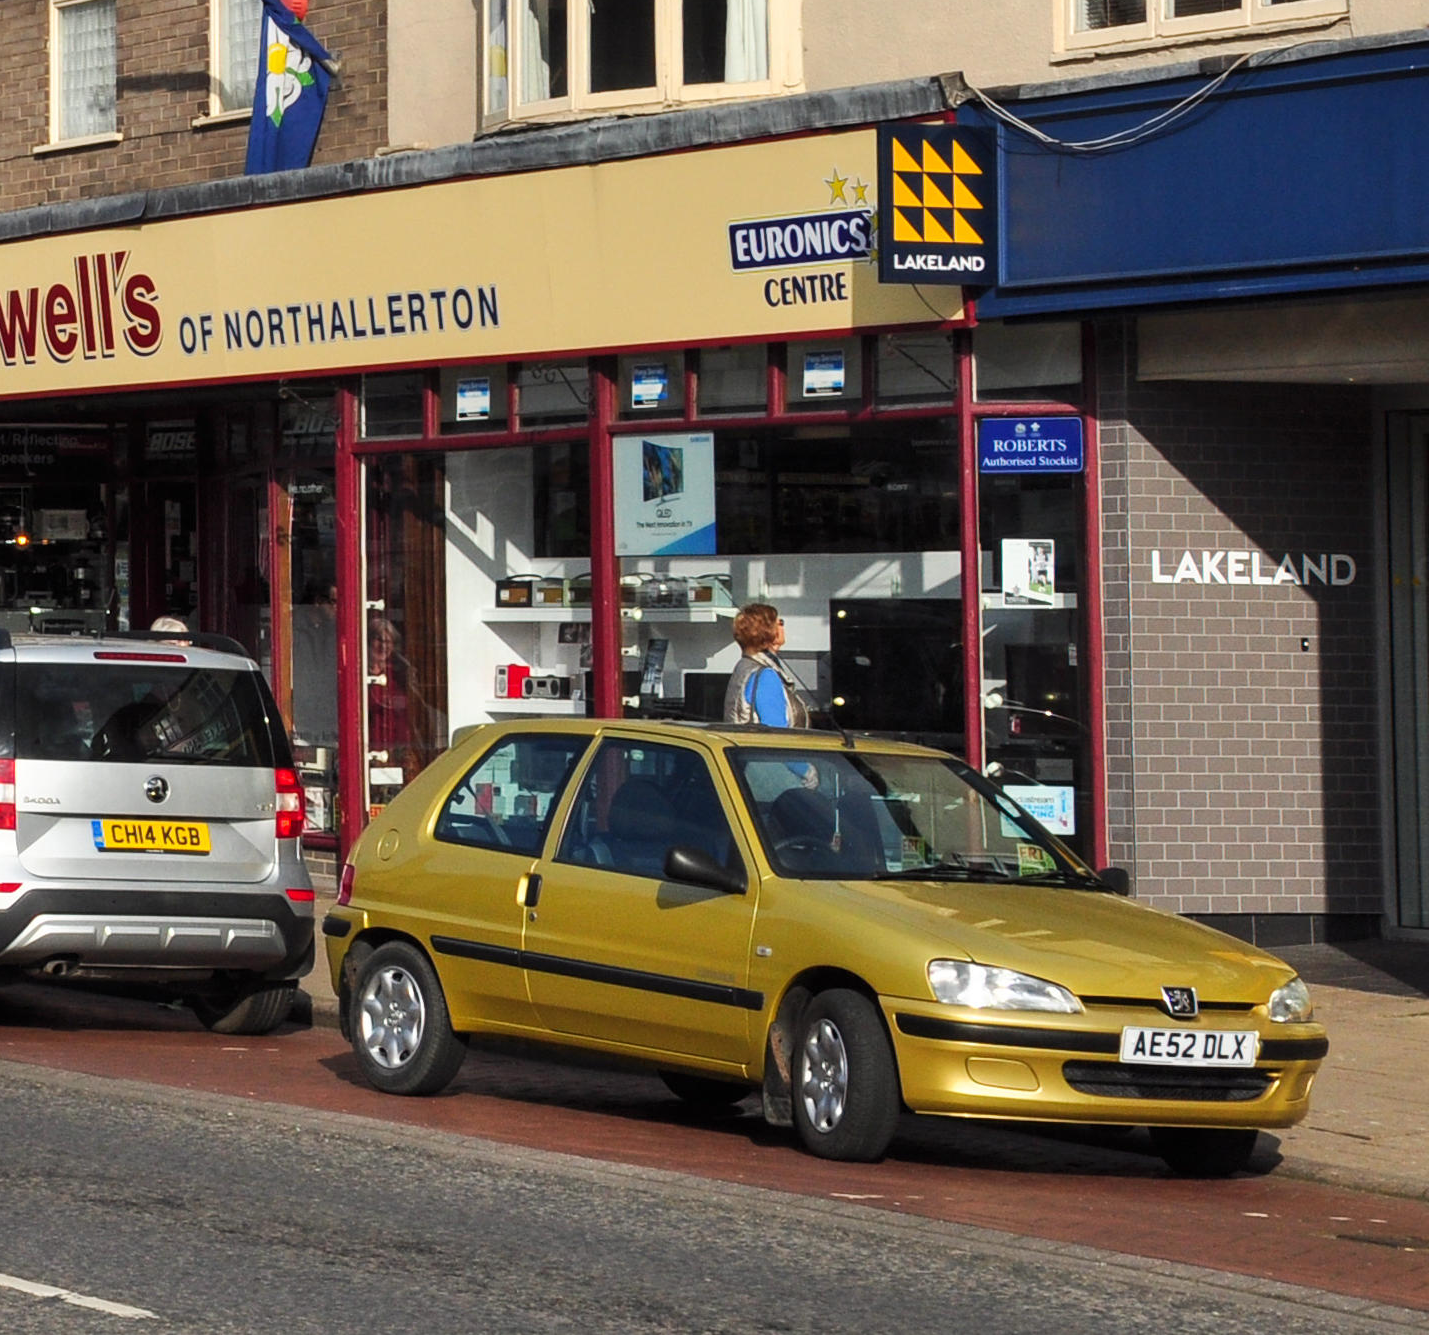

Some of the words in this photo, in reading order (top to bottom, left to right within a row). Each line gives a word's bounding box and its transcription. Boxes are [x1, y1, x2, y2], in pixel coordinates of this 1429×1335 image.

[734, 216, 867, 263] EURONICS
[893, 254, 985, 272] LAKELAND
[764, 271, 848, 308] CENTRE
[179, 314, 213, 354] OF
[223, 285, 499, 350] NORTHALLERTON
[982, 456, 1036, 467] Authorised
[1039, 455, 1078, 466] Stockist
[993, 439, 1067, 453] ROBERTS
[1151, 549, 1357, 586] LAKELAND
[111, 824, 156, 844] CH14
[163, 826, 201, 846] KGB
[1133, 1030, 1197, 1059] AE52
[1202, 1033, 1246, 1060] DLX
